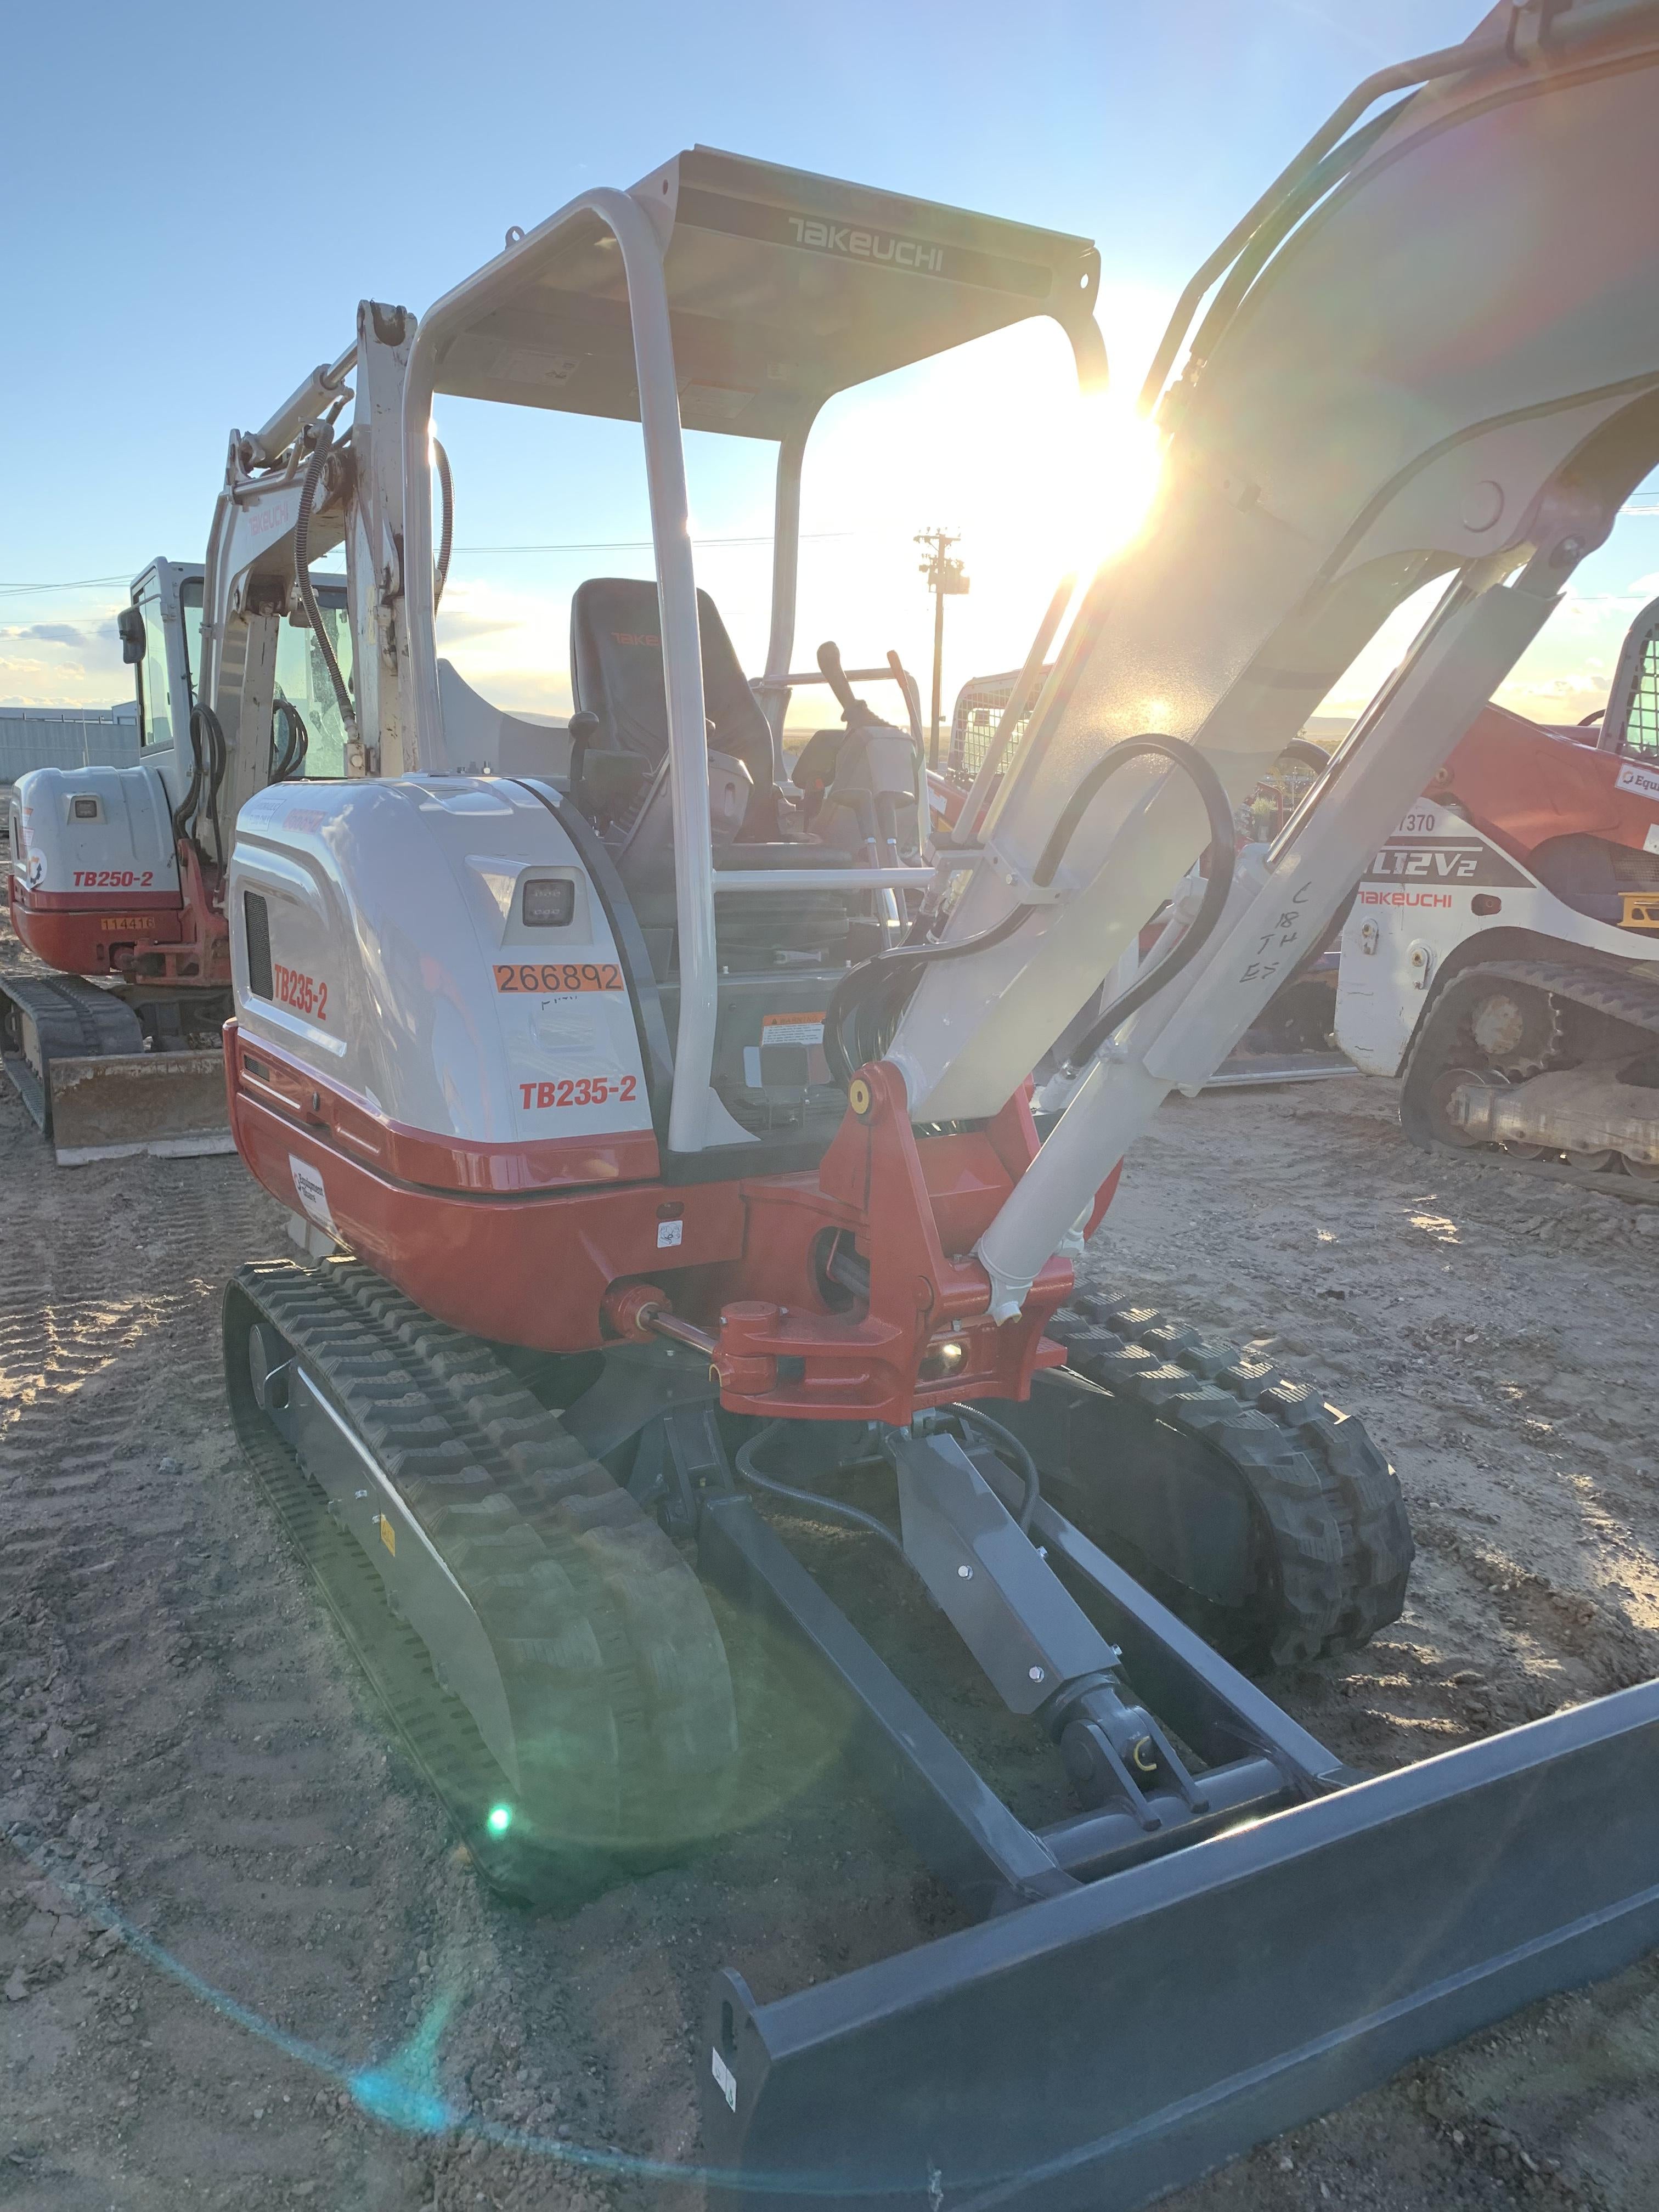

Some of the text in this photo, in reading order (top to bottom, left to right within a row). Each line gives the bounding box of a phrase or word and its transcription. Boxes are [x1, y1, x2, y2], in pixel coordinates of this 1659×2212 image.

[611, 631, 661, 647] TAKE
[1363, 851, 1477, 877] L12V2
[74, 871, 153, 887] TB250-2
[103, 918, 153, 930] 114416
[1275, 911, 1300, 929] 18
[497, 964, 622, 991] 266892
[274, 963, 328, 1021] TB235-2
[520, 1075, 636, 1109] TB235-2
[298, 1172, 324, 1197] Equipment
